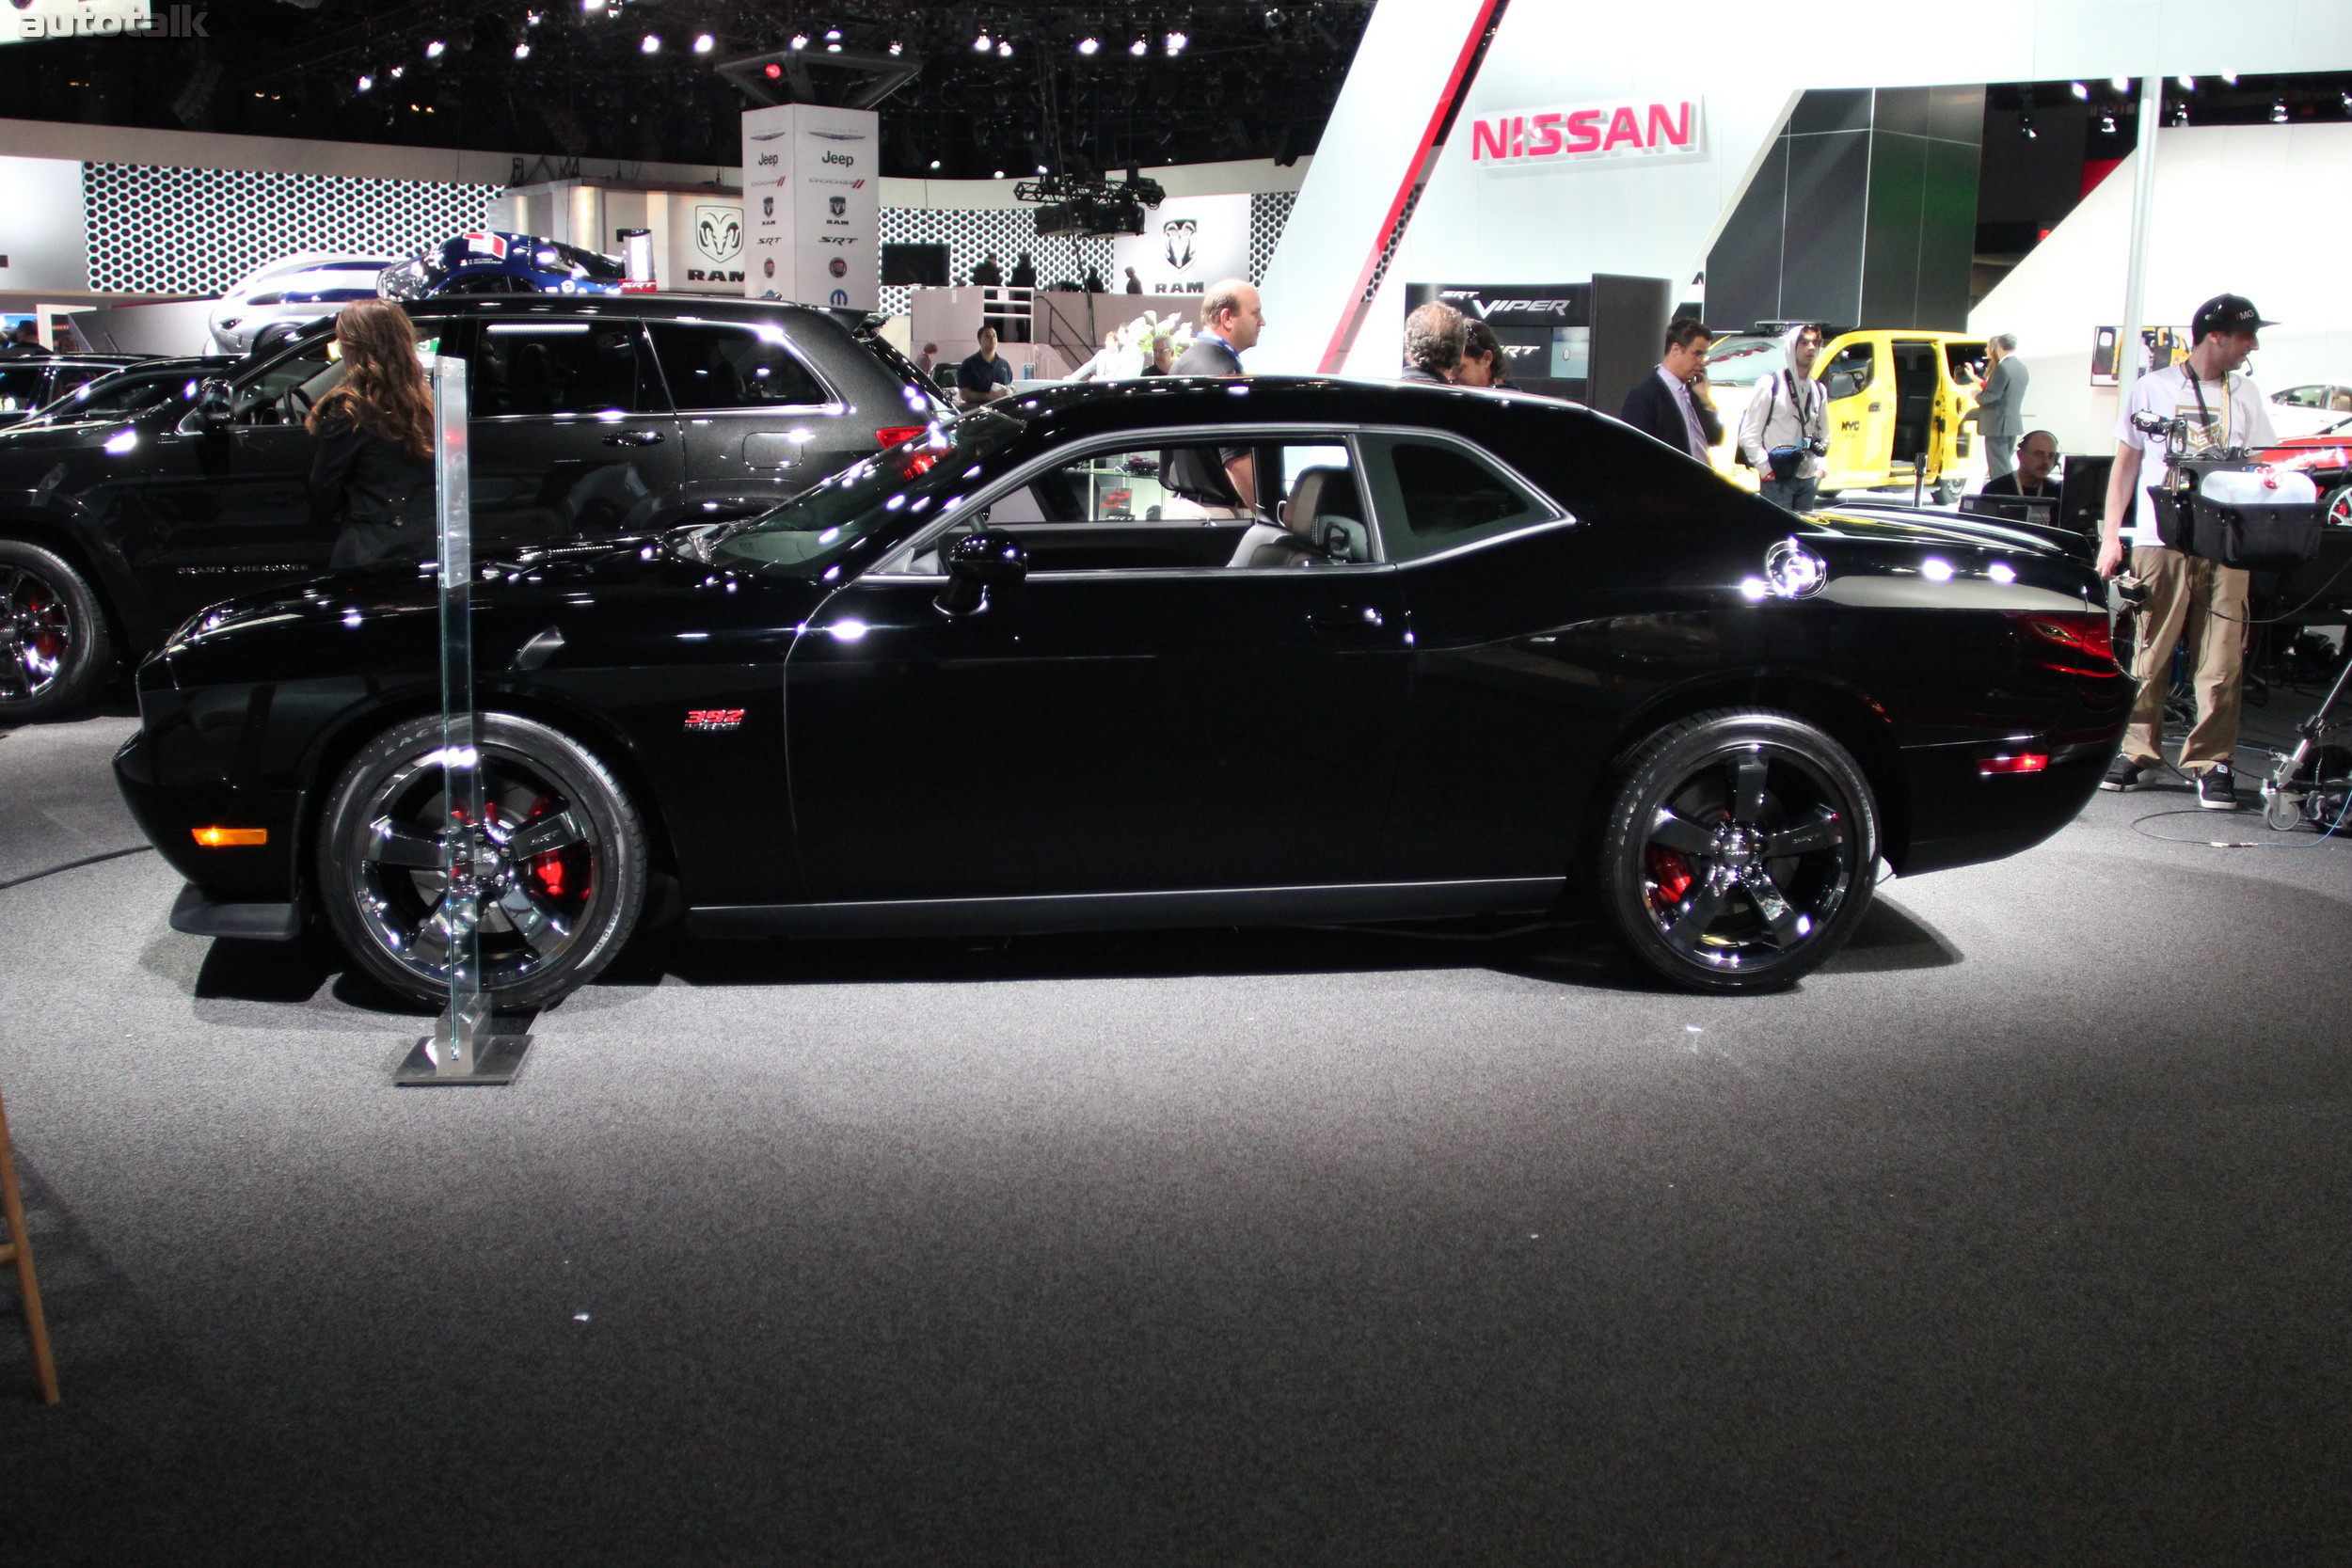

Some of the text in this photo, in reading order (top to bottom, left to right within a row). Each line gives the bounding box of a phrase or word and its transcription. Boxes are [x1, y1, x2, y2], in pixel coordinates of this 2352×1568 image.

[1472, 102, 1692, 161] NISSAN
[757, 152, 779, 167] Jeep
[821, 150, 854, 167] Jeep
[756, 237, 782, 245] SRT
[818, 236, 859, 245] SRT
[1154, 281, 1204, 293] RAM
[1438, 290, 1571, 320] SRT VIPER
[1500, 345, 1541, 358] RT
[1841, 420, 1861, 431] NYC
[684, 708, 746, 723] 392
